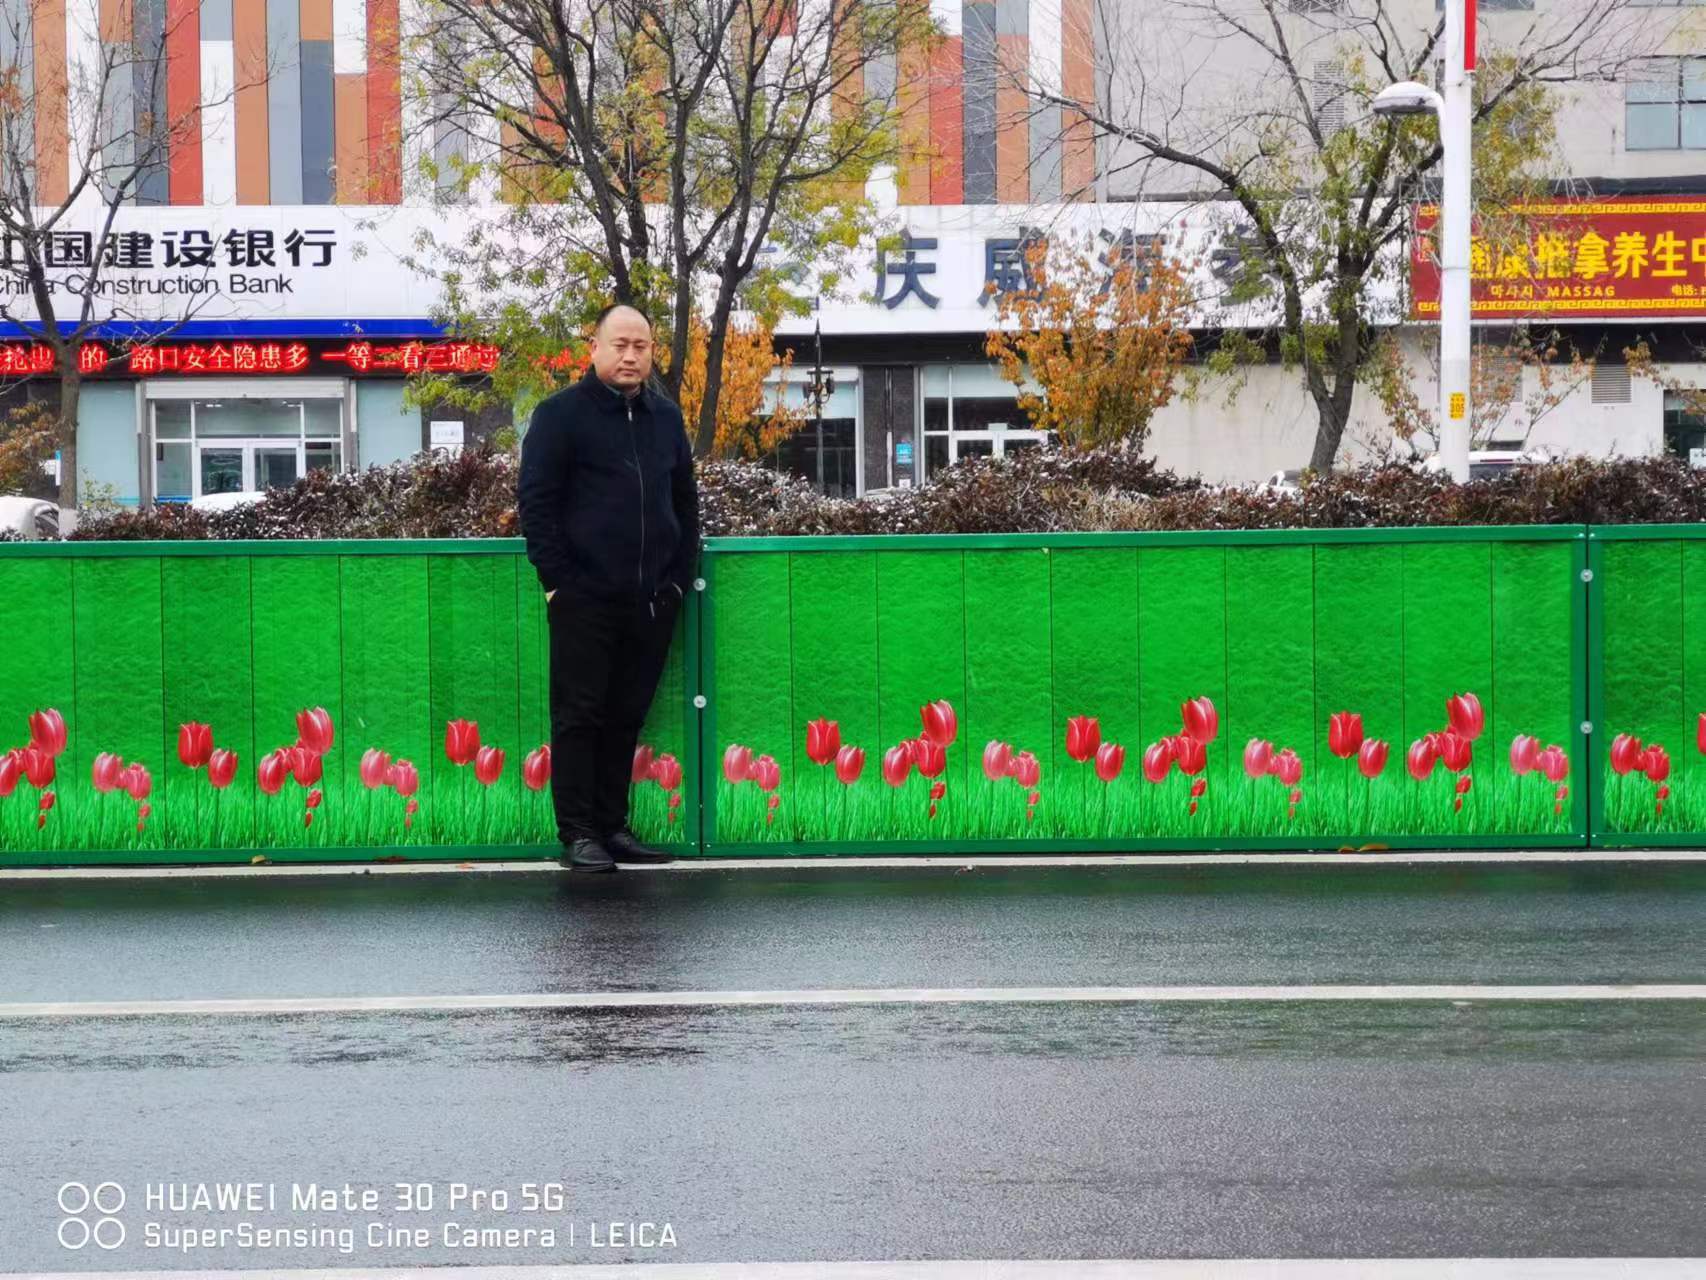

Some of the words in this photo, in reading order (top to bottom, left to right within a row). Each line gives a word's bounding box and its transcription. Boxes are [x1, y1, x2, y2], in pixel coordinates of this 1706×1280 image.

[0, 274, 55, 295] hina
[65, 273, 219, 295] Construction
[230, 273, 294, 294] Bank
[1546, 285, 1616, 298] MASSAG
[130, 343, 309, 370] 路口安全隐患多
